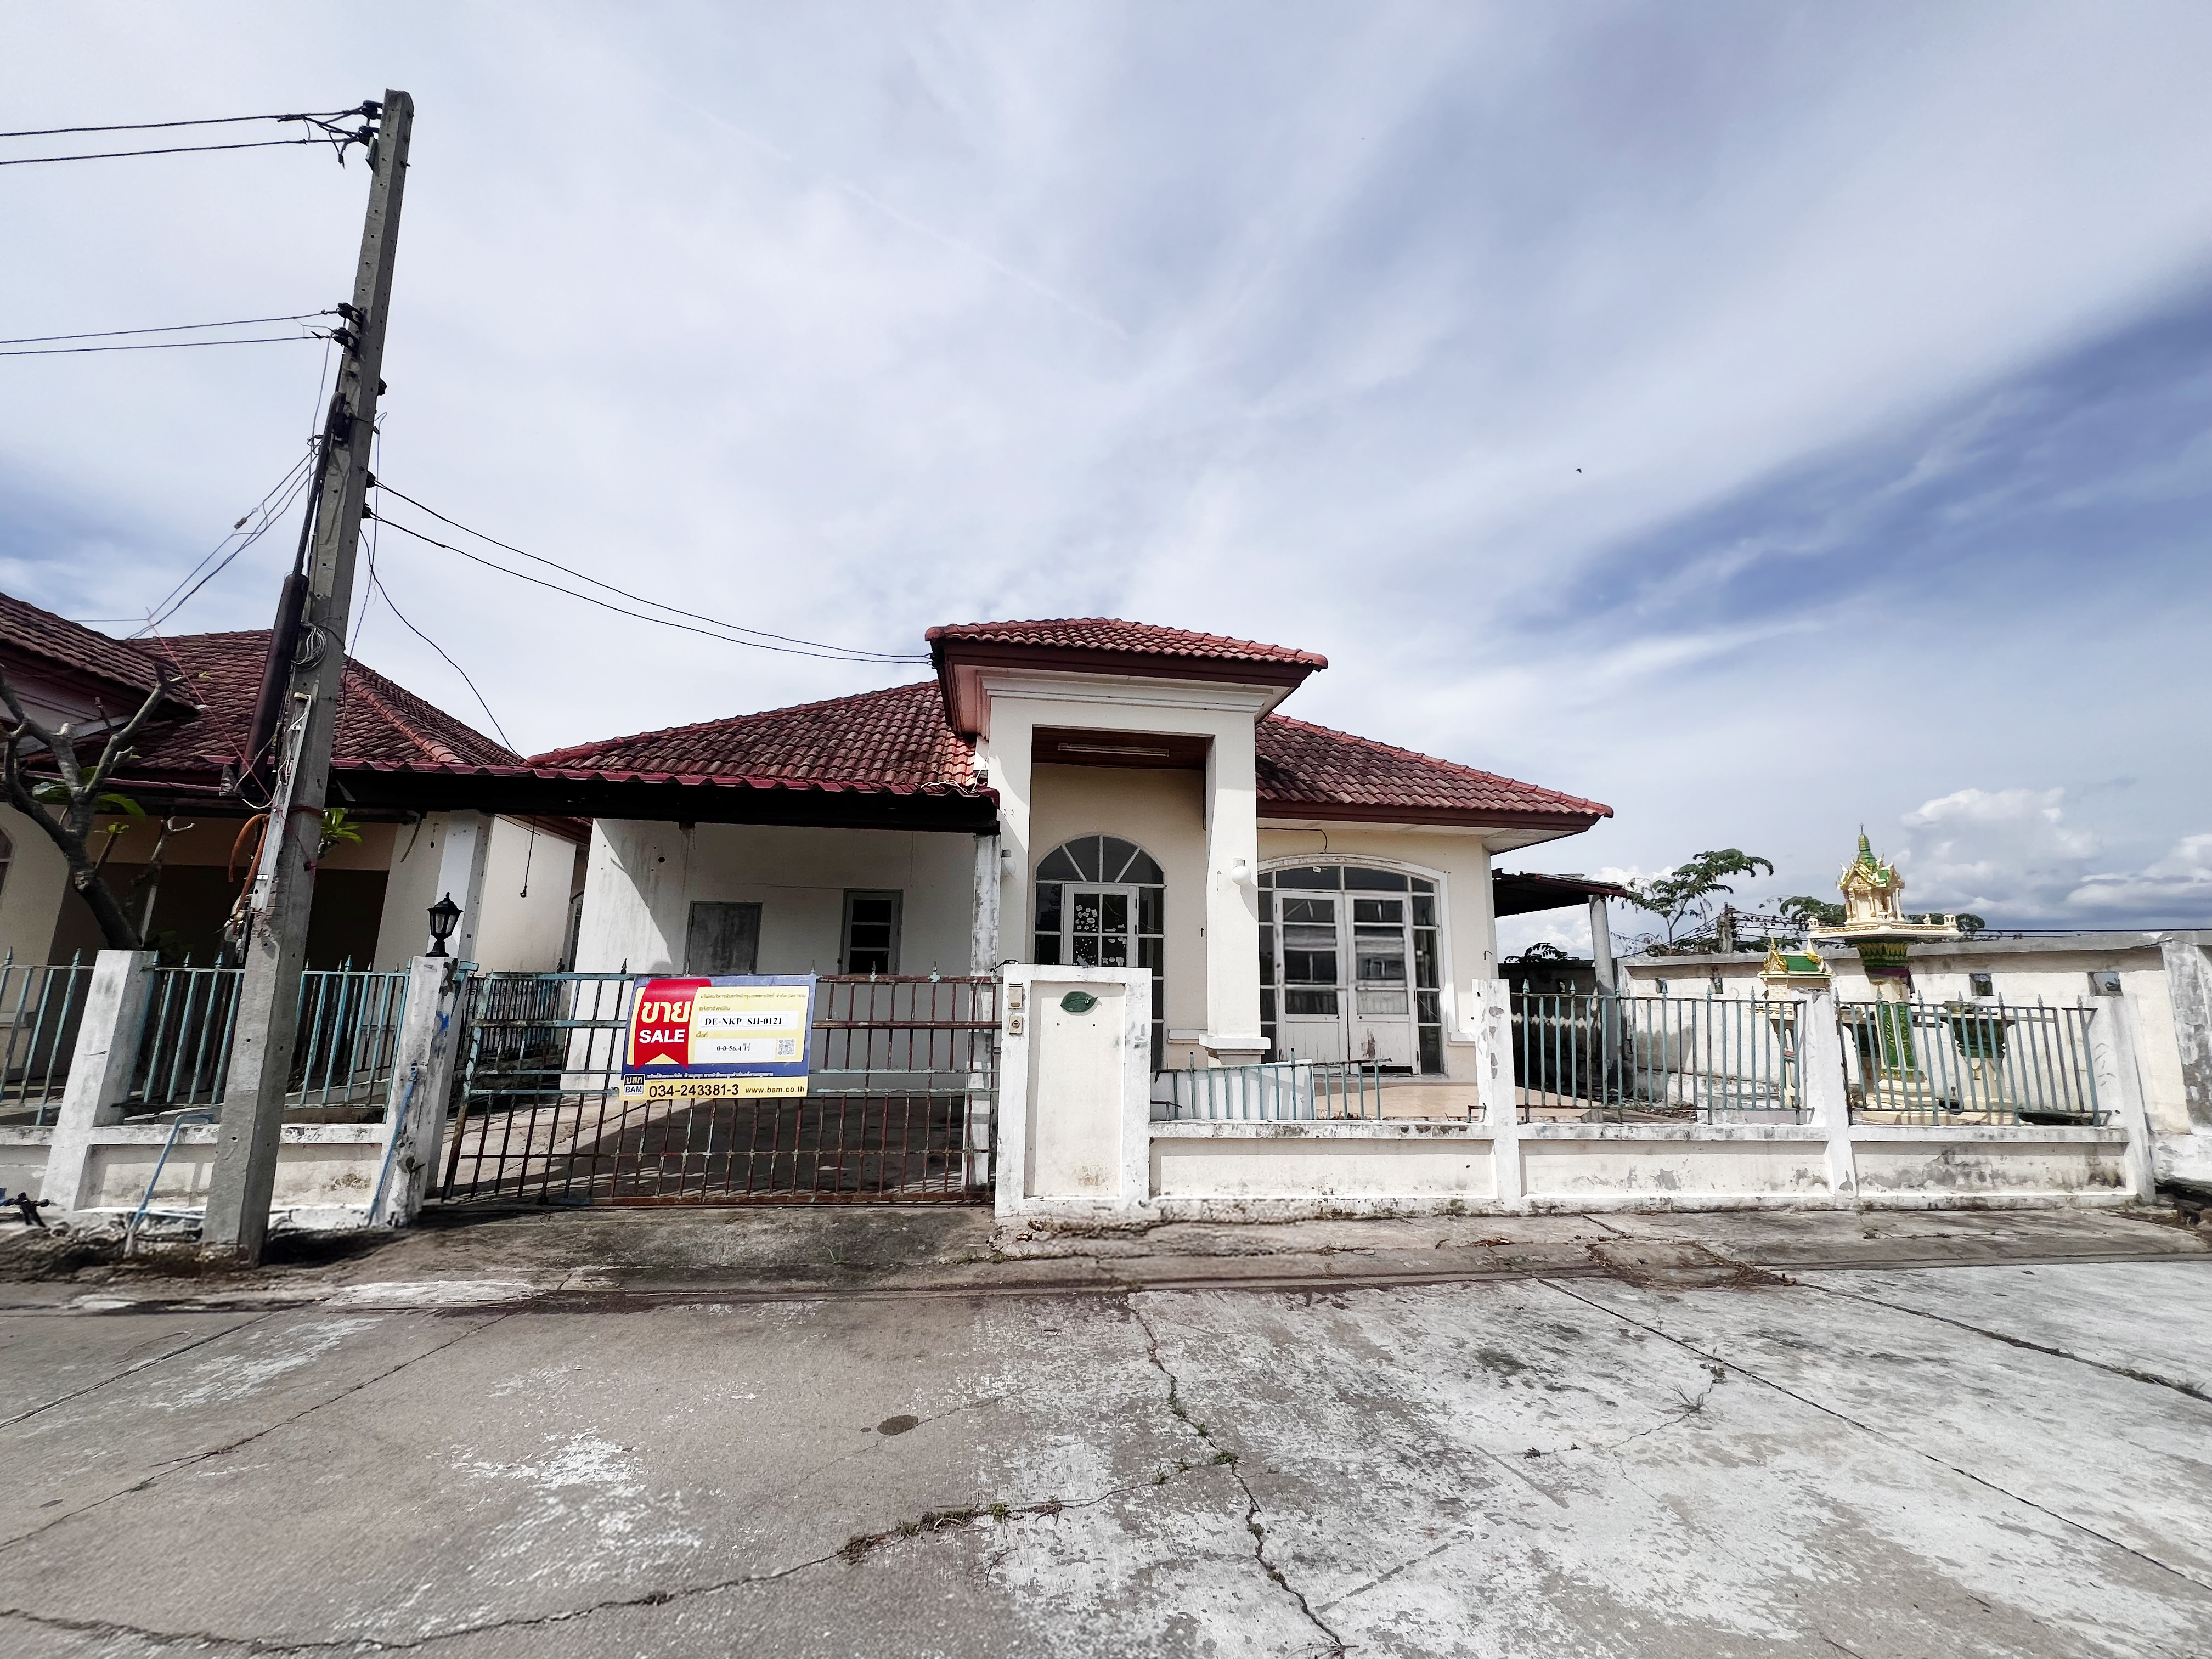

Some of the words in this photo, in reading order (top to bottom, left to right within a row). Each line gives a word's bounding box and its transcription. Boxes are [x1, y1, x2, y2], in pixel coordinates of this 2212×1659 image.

[641, 1001, 691, 1023] ขาย
[639, 1029, 686, 1043] SALE
[649, 1084, 739, 1097] 034-243381-3
